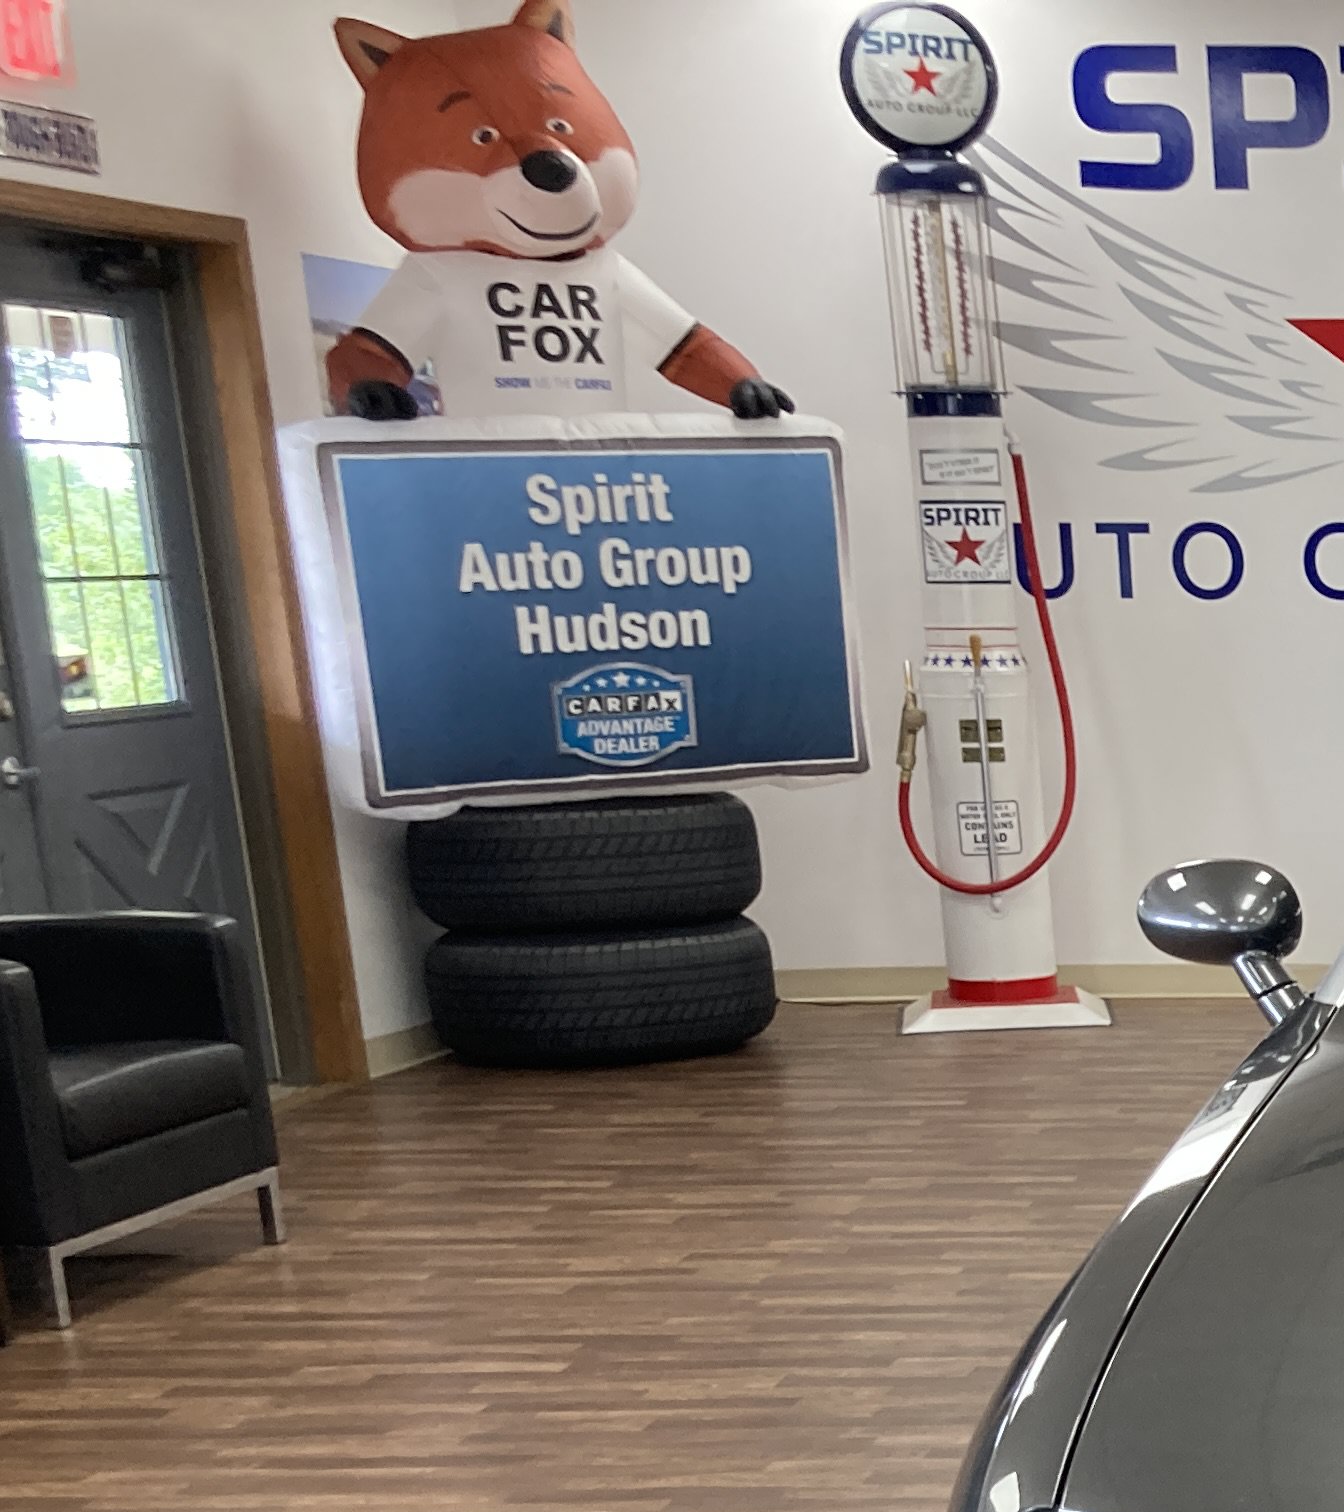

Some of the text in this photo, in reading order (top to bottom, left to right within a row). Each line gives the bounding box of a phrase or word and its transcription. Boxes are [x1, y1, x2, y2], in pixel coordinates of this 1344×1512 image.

[862, 30, 973, 61] SPIRIT
[487, 282, 603, 321] CAR
[497, 325, 604, 364] FOX
[526, 472, 674, 535] Spirit
[923, 507, 1001, 526] SPIRIT
[459, 536, 752, 594] Auto Group
[1012, 521, 1245, 601] UTO
[515, 603, 712, 655] Hudson
[567, 692, 681, 716] CARFAX
[577, 716, 676, 738] ADVANTAGE
[593, 735, 660, 755] DEALER
[964, 822, 1014, 830] CONAINS
